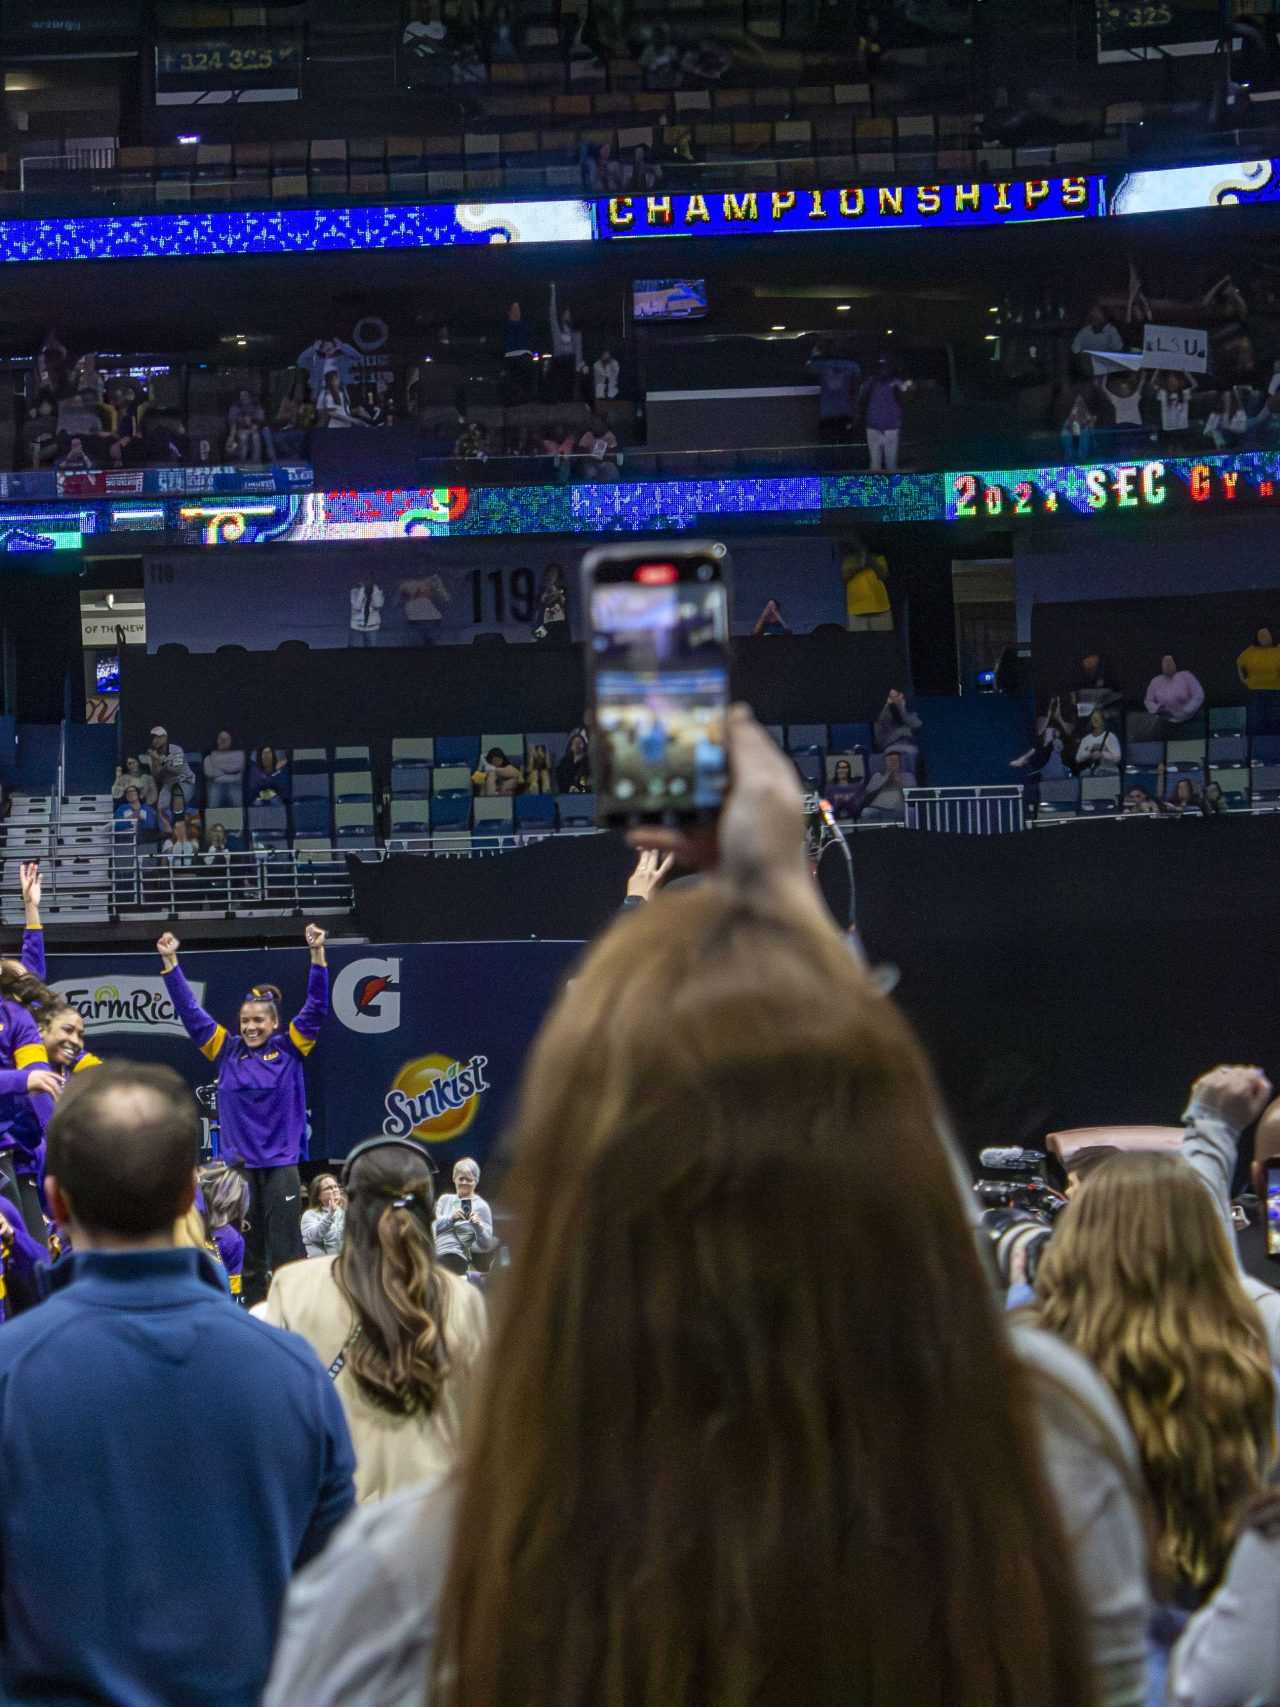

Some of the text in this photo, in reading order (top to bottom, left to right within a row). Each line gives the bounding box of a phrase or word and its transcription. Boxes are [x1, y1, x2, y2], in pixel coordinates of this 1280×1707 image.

[609, 177, 1086, 225] CHAMPIONSHIPS
[1087, 461, 1166, 509] SEC
[470, 566, 535, 624] 119
[84, 624, 144, 634] OF TH NEW
[65, 989, 178, 1024] FarmRic
[332, 957, 402, 1034] G
[384, 1056, 488, 1139] Sunkist
